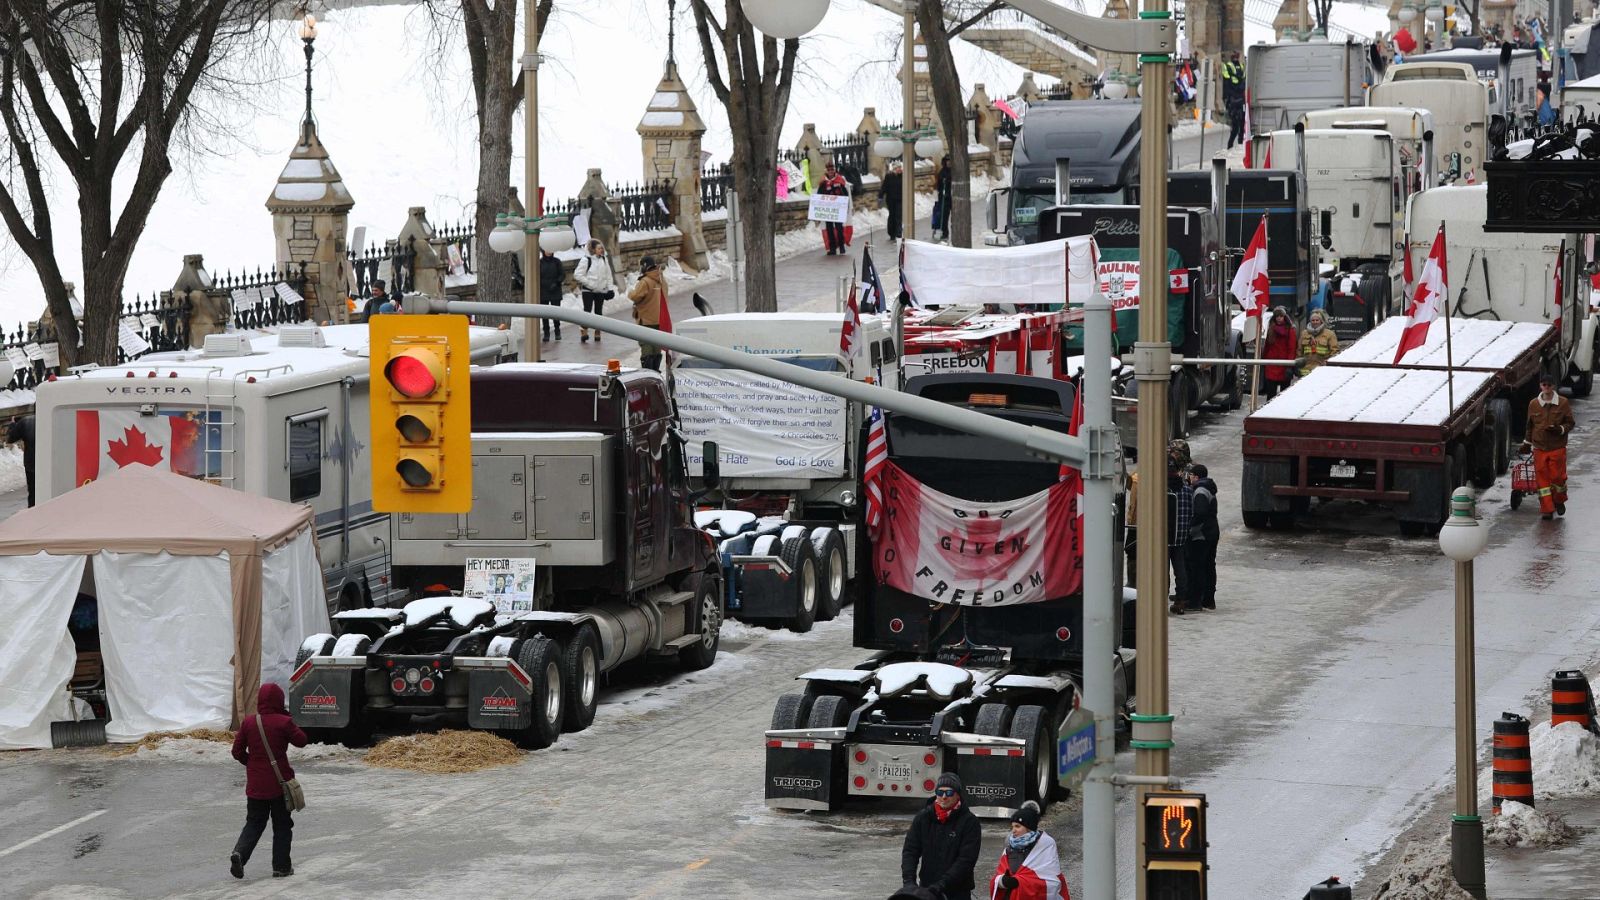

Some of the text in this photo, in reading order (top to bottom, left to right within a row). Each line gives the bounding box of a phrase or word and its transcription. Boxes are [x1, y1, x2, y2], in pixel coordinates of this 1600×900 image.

[700, 392, 740, 400] themselves,
[808, 394, 818, 403] My
[821, 394, 837, 402] face,
[748, 418, 770, 427] forgive
[726, 453, 749, 464] Hate
[776, 456, 834, 467] God is Love
[953, 508, 1012, 518] GOD
[941, 536, 1024, 554] GIVEN
[467, 560, 484, 570] HEY
[485, 559, 510, 570] MEDIA
[916, 566, 1043, 606] FREEDOM
[303, 696, 336, 705] TEAM
[483, 697, 516, 707] TEAM
